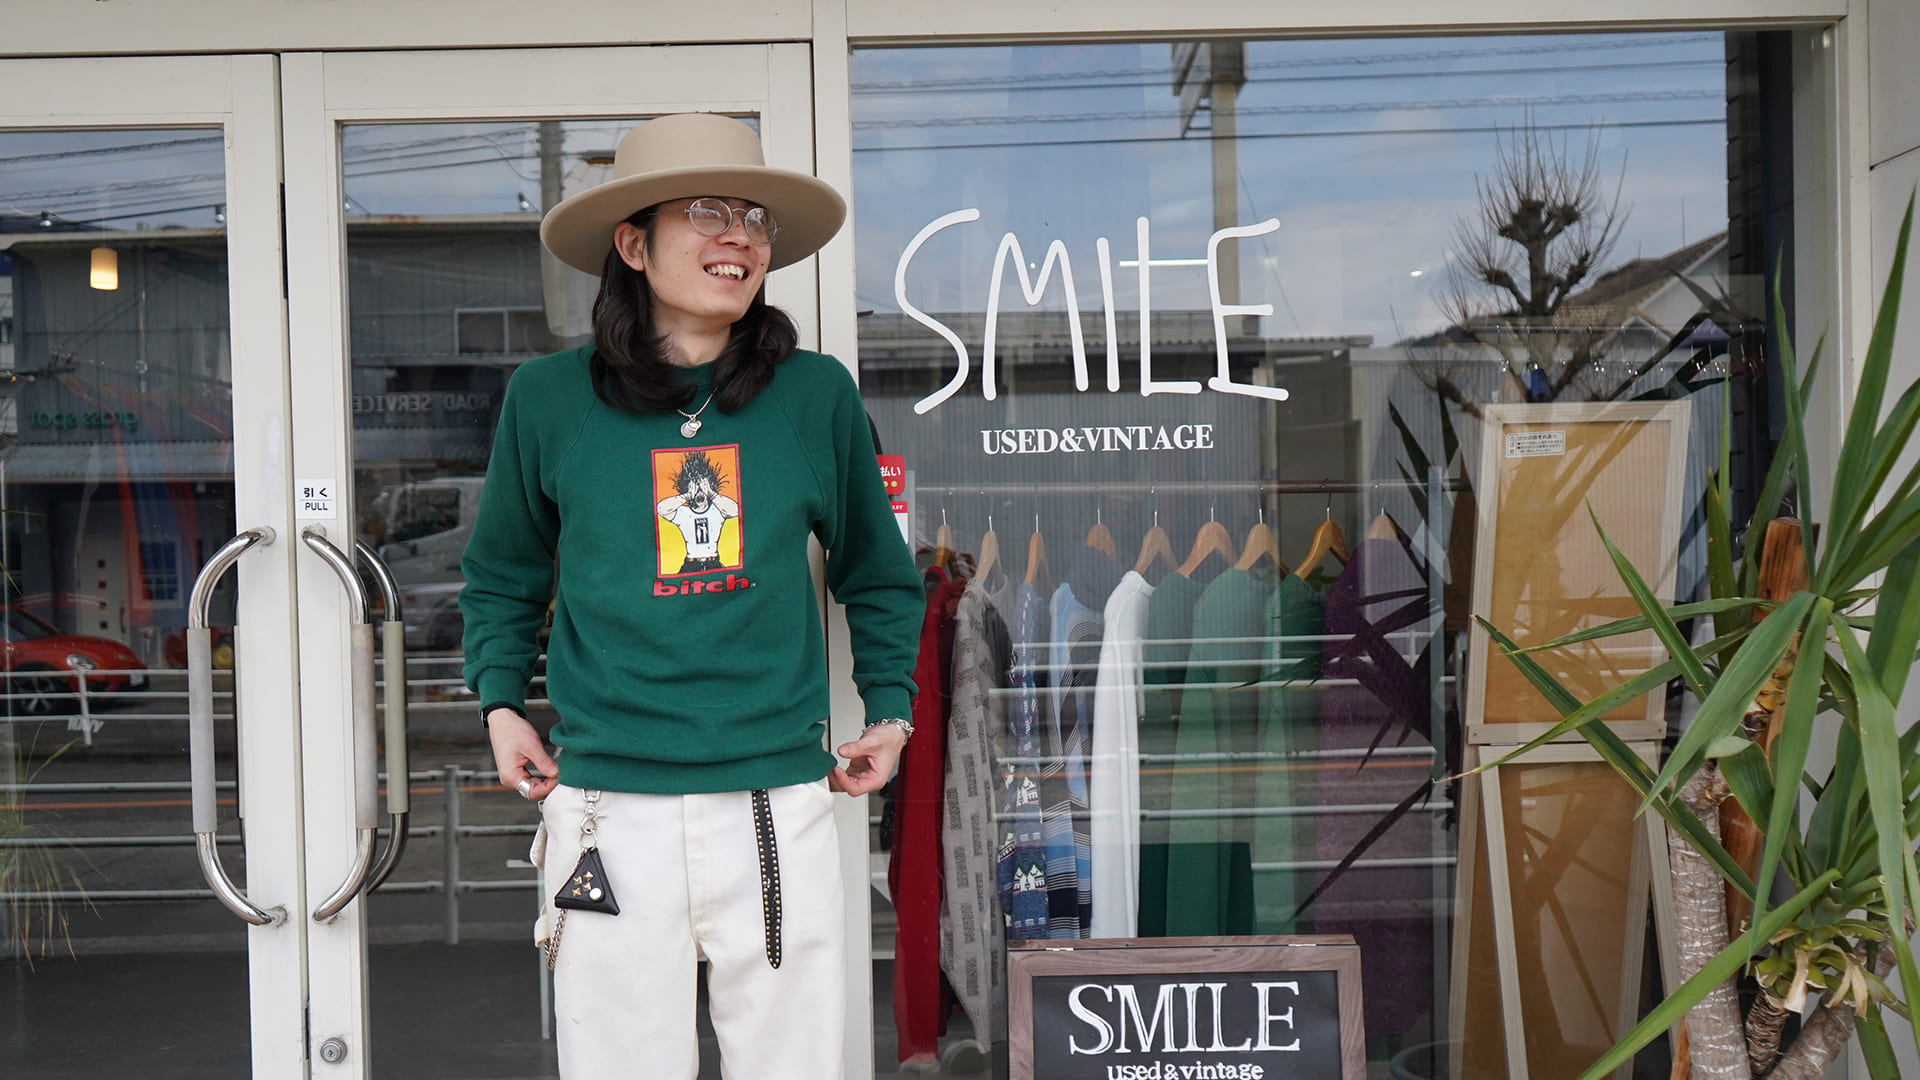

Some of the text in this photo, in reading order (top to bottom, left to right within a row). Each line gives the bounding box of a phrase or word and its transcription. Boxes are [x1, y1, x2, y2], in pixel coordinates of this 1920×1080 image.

[894, 207, 1290, 416] SMILE
[980, 424, 1215, 456] USED&VINTAGE
[304, 502, 329, 511] PULL
[653, 574, 750, 597] bitch
[1067, 980, 1301, 1056] SMILE
[1106, 1060, 1265, 1080] used&vintage
